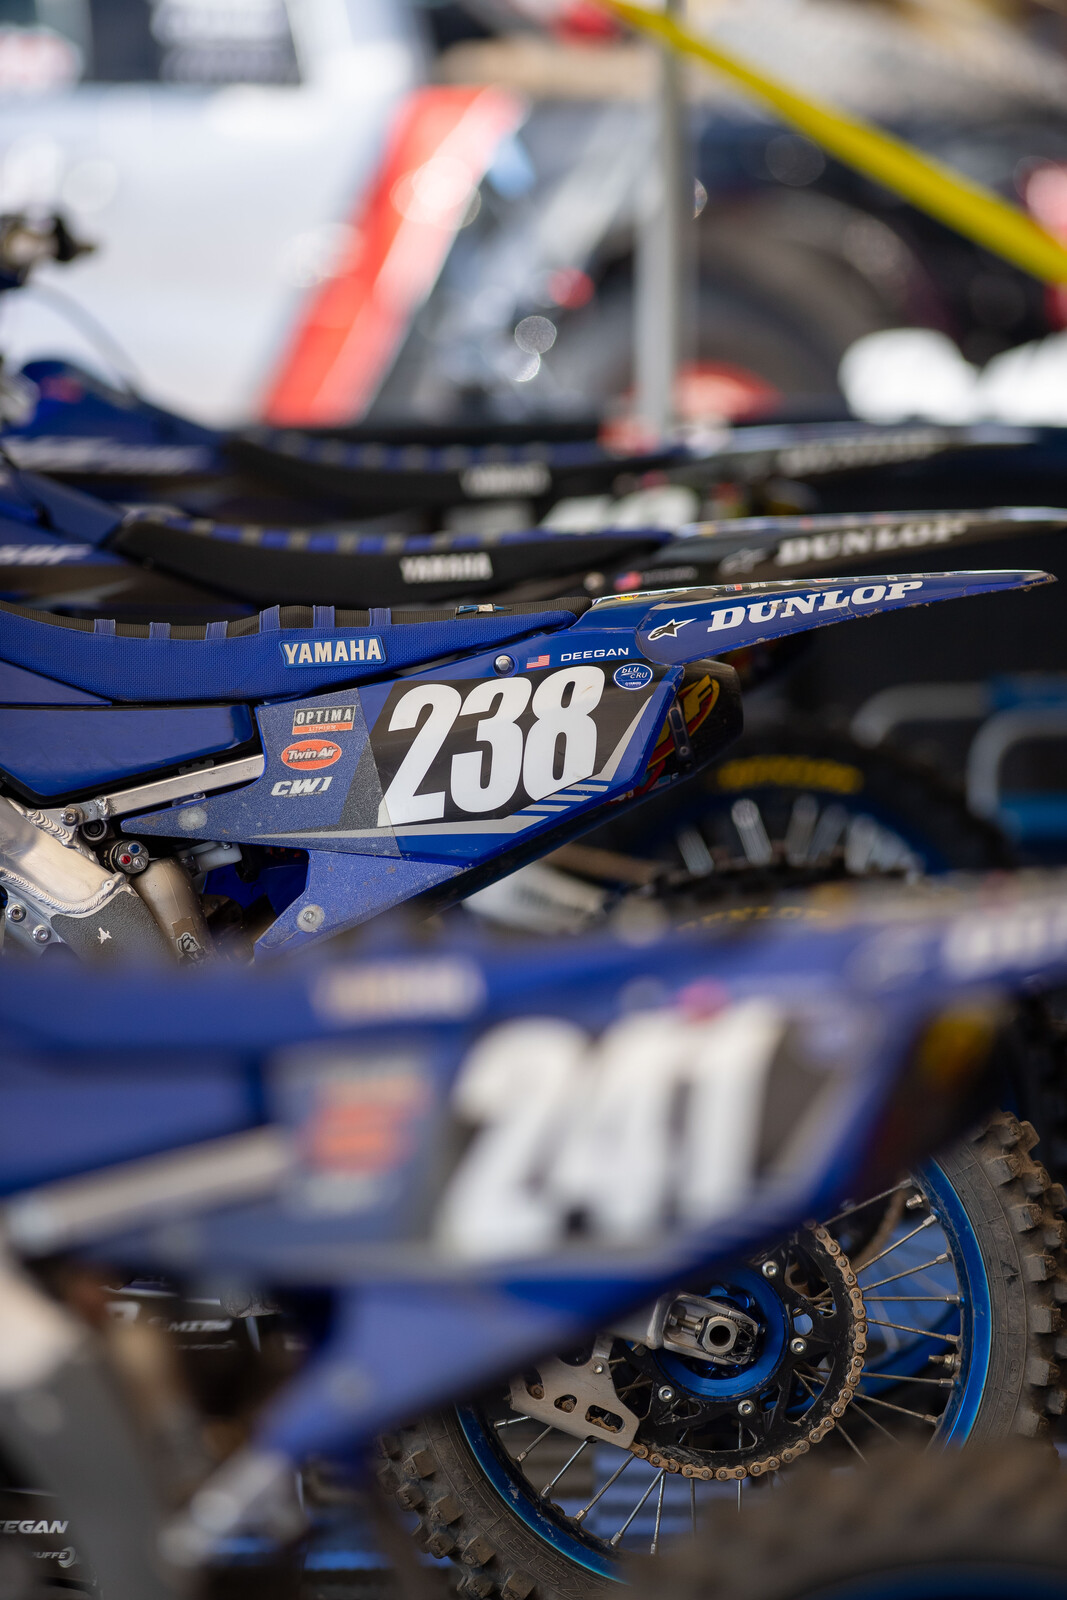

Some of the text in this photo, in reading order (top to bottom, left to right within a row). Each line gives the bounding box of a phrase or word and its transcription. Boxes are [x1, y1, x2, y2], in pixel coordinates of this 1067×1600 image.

[774, 519, 967, 567] DUNLOP
[400, 552, 493, 584] YAMAHA
[707, 581, 923, 632] DUNLOP
[283, 638, 382, 665] YAMAHA
[560, 648, 630, 662] DEEGAN
[296, 708, 352, 725] OPTIMA
[287, 746, 338, 761] Twin Air
[377, 665, 606, 828] 238
[434, 994, 785, 1260] 241
[0, 1520, 69, 1534] EGAN
